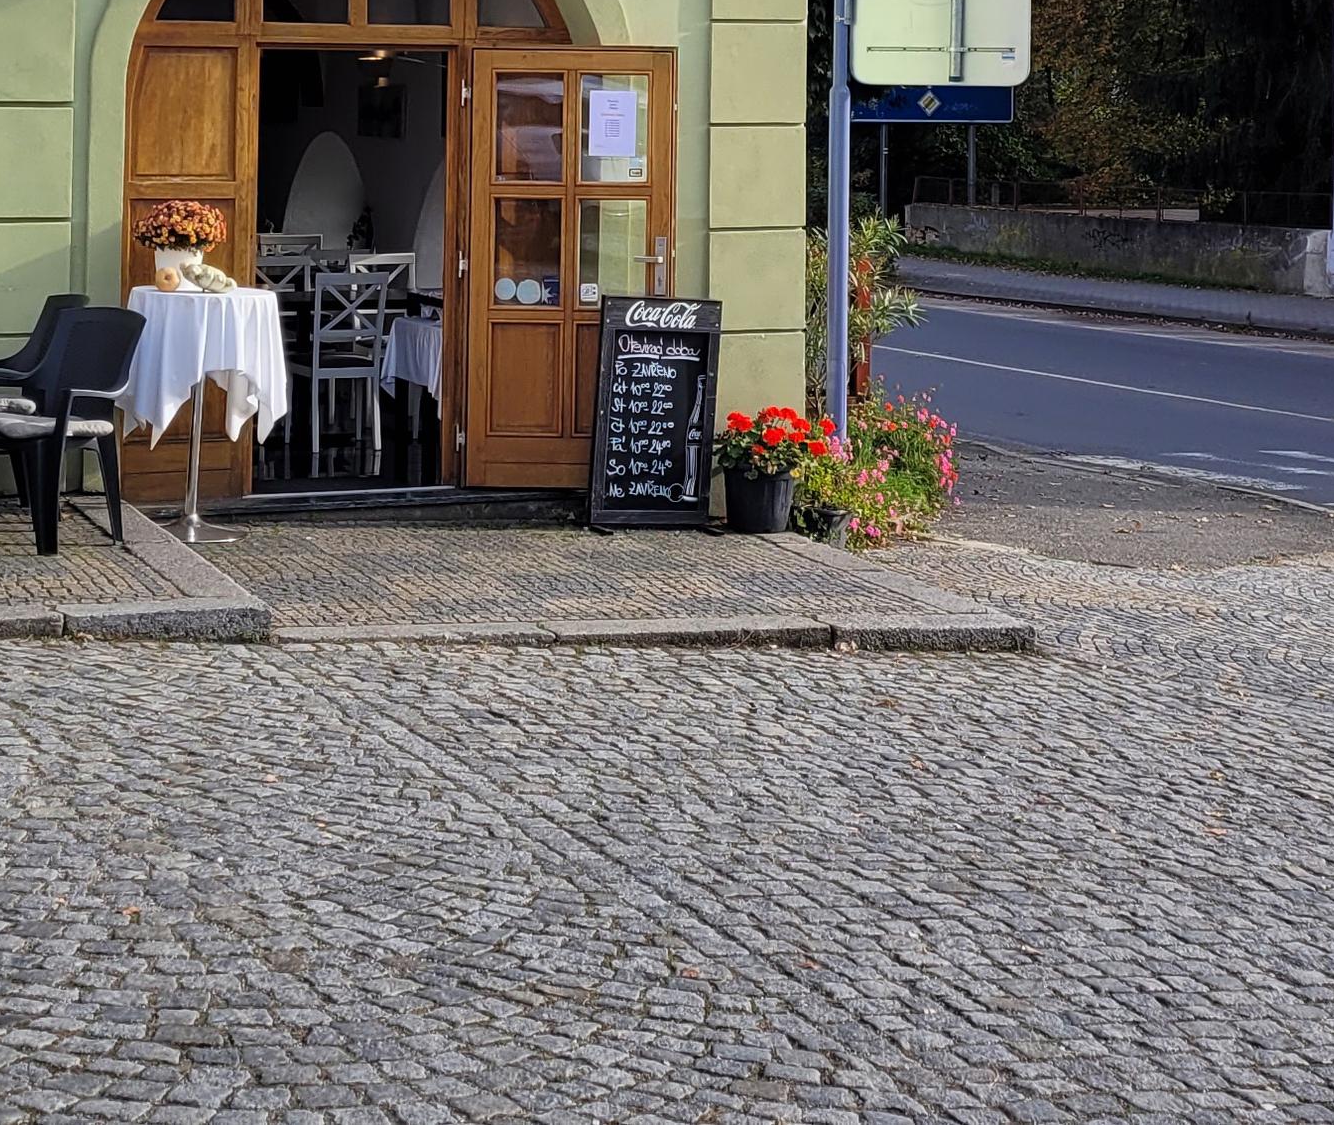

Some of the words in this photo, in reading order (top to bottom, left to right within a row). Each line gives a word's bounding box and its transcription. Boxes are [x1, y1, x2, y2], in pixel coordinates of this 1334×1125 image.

[625, 300, 702, 329] Coca-Cola
[666, 336, 701, 356] doba
[632, 361, 677, 379] ZAVŘENO
[611, 398, 626, 413] St
[606, 458, 626, 476] So
